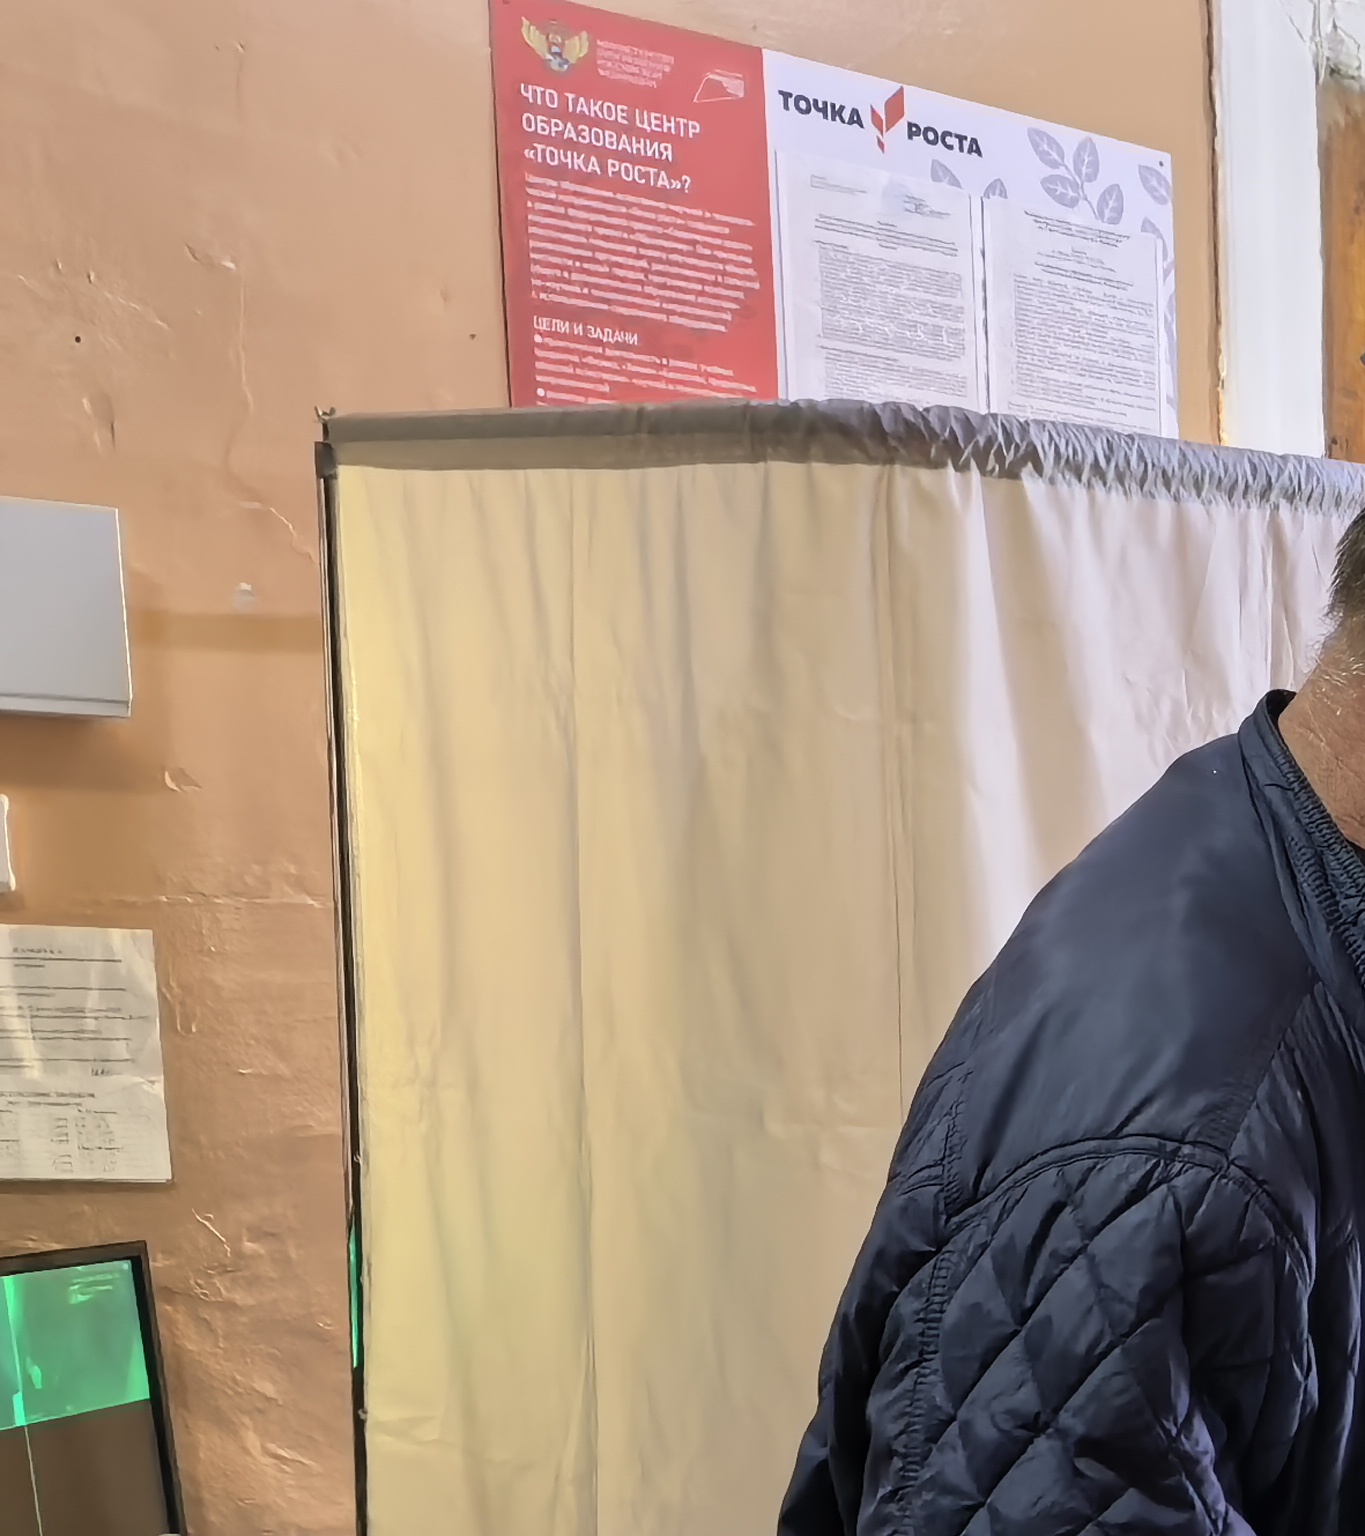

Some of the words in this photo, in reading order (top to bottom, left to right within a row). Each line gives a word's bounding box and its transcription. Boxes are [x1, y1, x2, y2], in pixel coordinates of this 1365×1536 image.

[520, 83, 559, 109] ЧТО
[563, 92, 629, 124] ТАКОЕ
[634, 108, 701, 139] ЦЕНТР
[521, 112, 674, 162] ОБРАЗОВАНИЯ
[777, 89, 865, 129] ТОЧКА
[906, 120, 983, 158] РОСТА
[523, 142, 601, 175] «ТОЧКА
[607, 159, 692, 193] РОСТА»?
